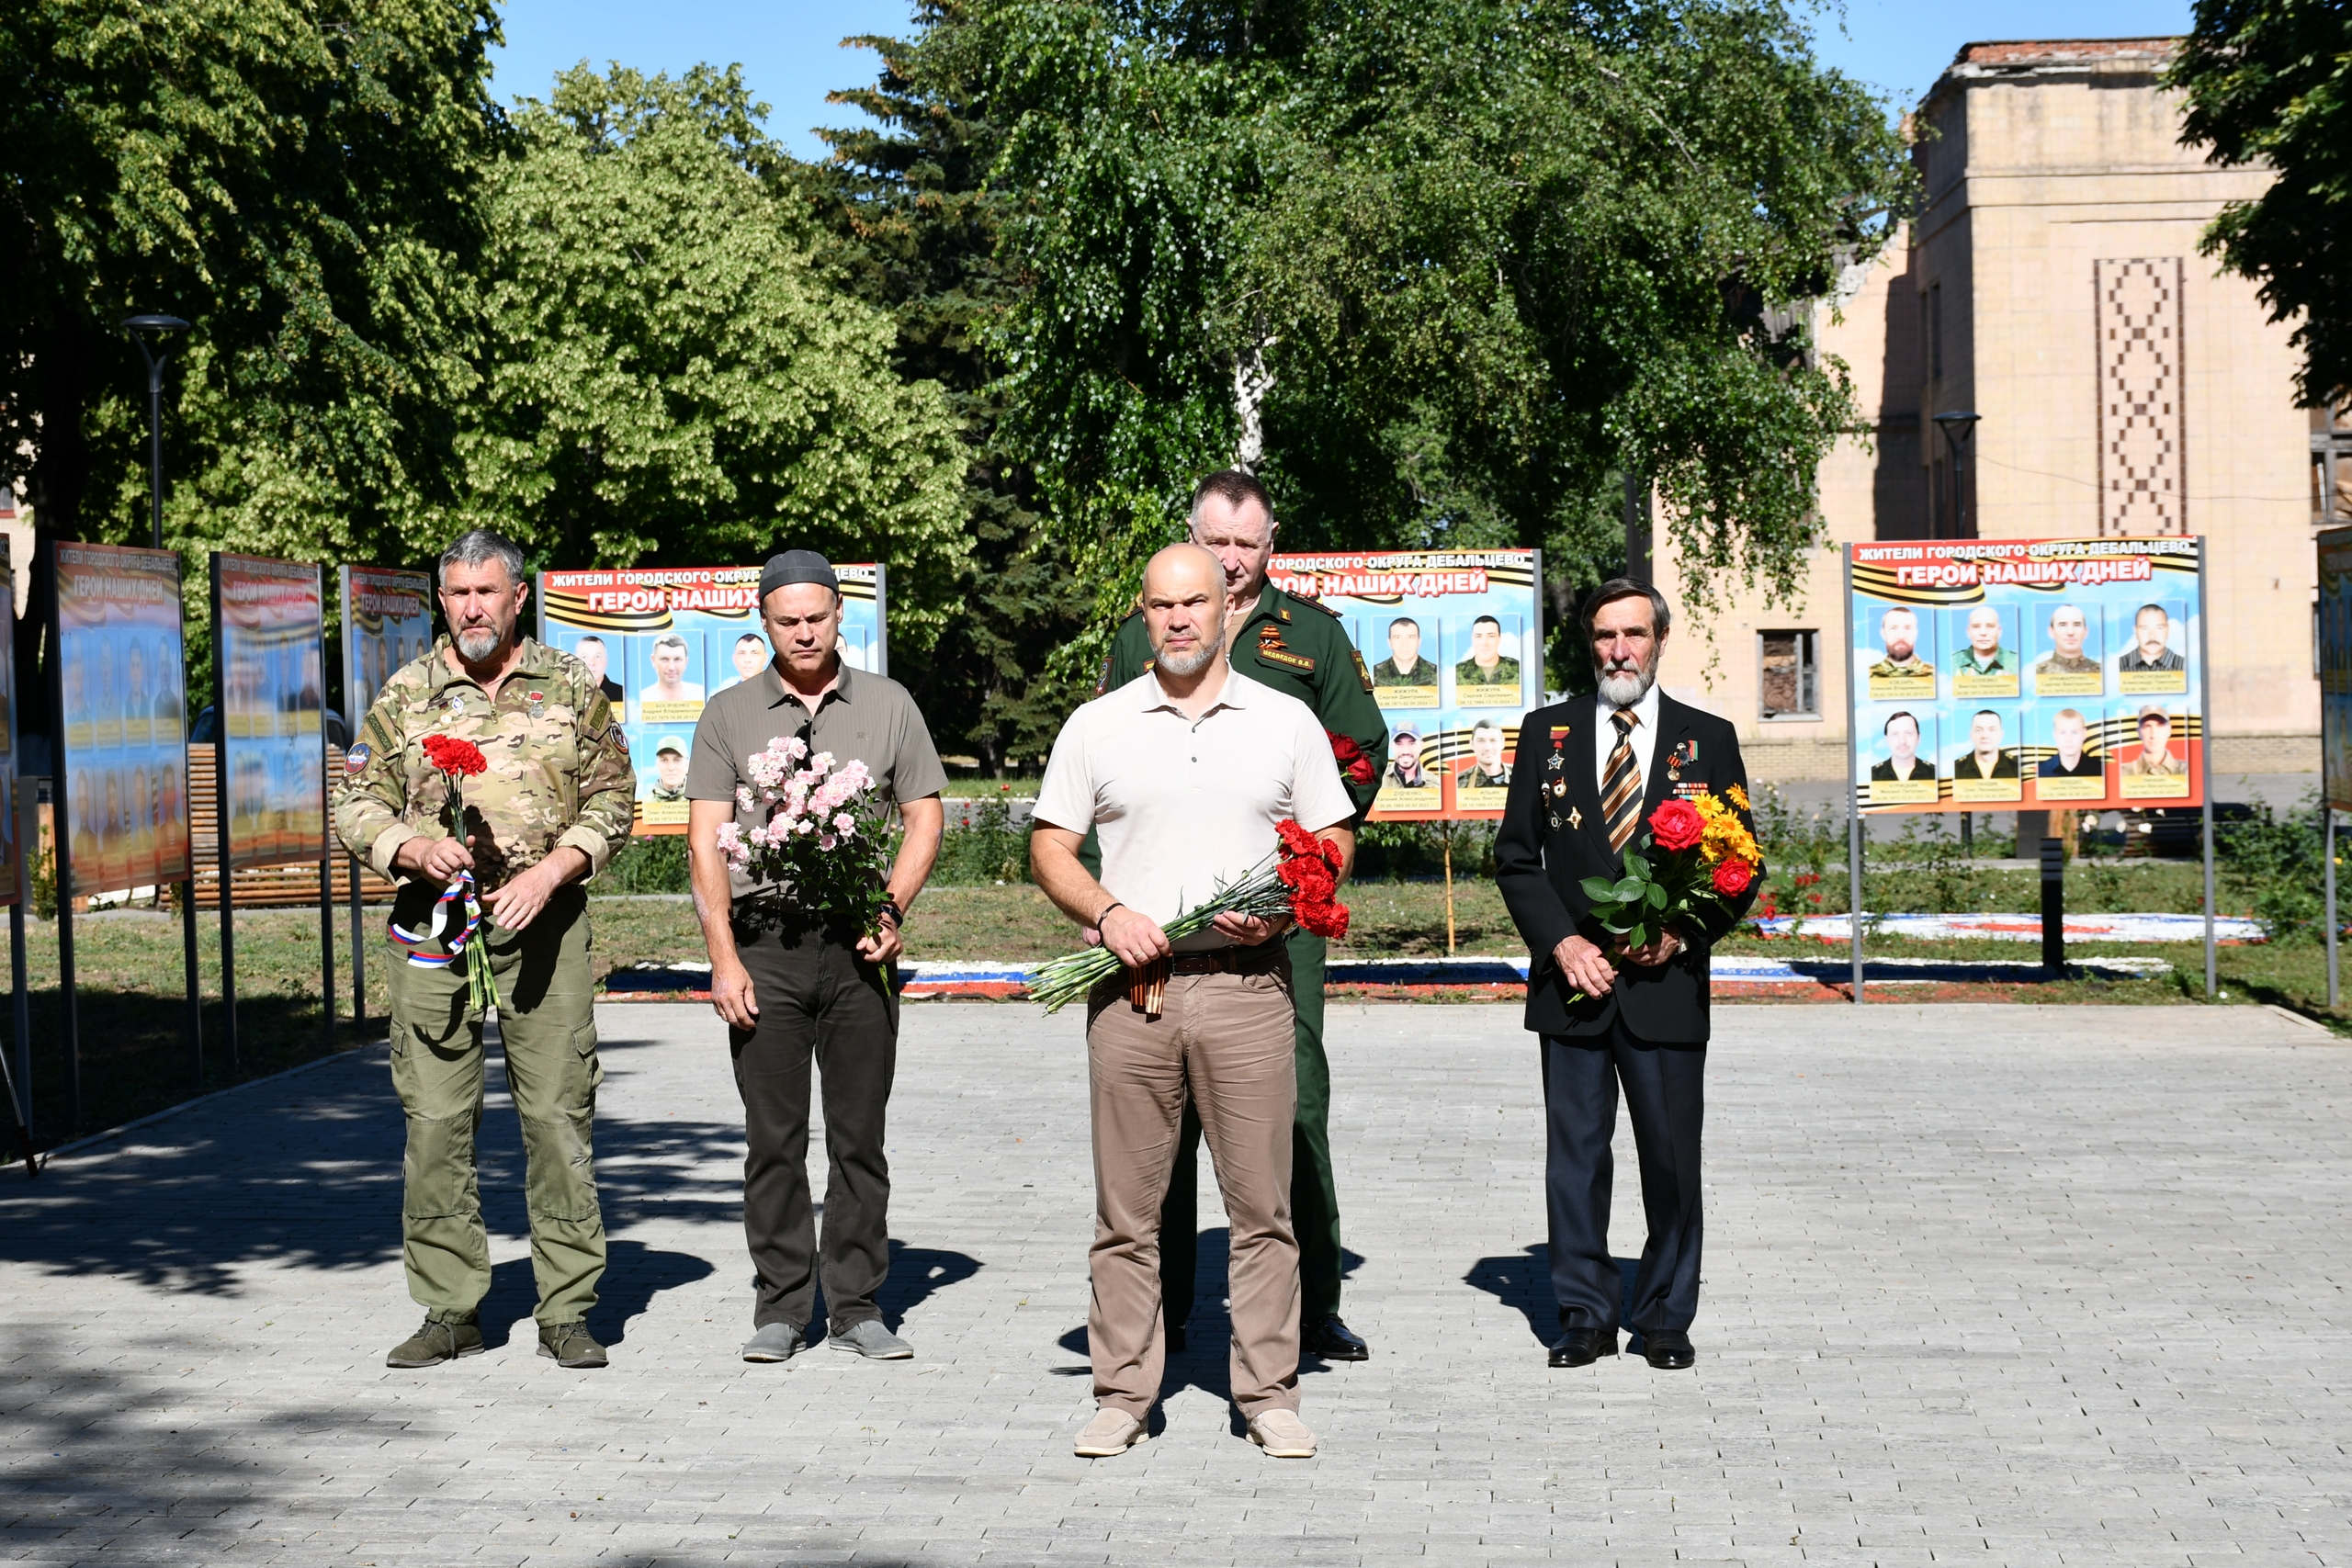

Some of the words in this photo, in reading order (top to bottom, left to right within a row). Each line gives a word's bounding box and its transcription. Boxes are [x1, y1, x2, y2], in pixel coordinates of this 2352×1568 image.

[60, 549, 84, 564] ЖИТЕЛИ
[84, 552, 119, 569] ГОРОДСКОГО
[1859, 547, 1923, 560] ЖИТЕЛИ
[1927, 544, 2025, 560] ГОРОДСКОГО
[2028, 543, 2086, 557] ОКРУГА
[2088, 541, 2190, 557] ДЕБАЛЬЦЕВО
[1267, 556, 1364, 572] ГОРОДСКОГО
[1367, 555, 1423, 569] ОКРУГА
[1425, 553, 1525, 569] ДЕБАЛЬЦЕВО
[1897, 563, 1978, 585] ГЕРОИ
[1984, 561, 2077, 583] НАШИХ
[2080, 556, 2151, 585] ДНЕЙ
[551, 573, 613, 587] ЖИТЕЛИ
[616, 570, 711, 586] ГОРОДСКОГО
[714, 570, 761, 582] ОКРУГ
[1271, 575, 1317, 594] РОИ
[1324, 574, 1415, 594] НАШИХ
[1419, 569, 1487, 595] ДНЕЙ
[74, 575, 104, 598] ГЕРОИ
[105, 577, 138, 600] НАШИХ
[139, 577, 164, 604] ДНЕЙ
[589, 590, 665, 611] ГЕРОИ
[672, 588, 761, 608] НАШИХ
[362, 593, 381, 612] ГЕРОИ
[381, 594, 403, 613] НАШИХ
[1262, 649, 1297, 664] МЕДВЕДОК
[1297, 659, 1311, 668] В.В.
